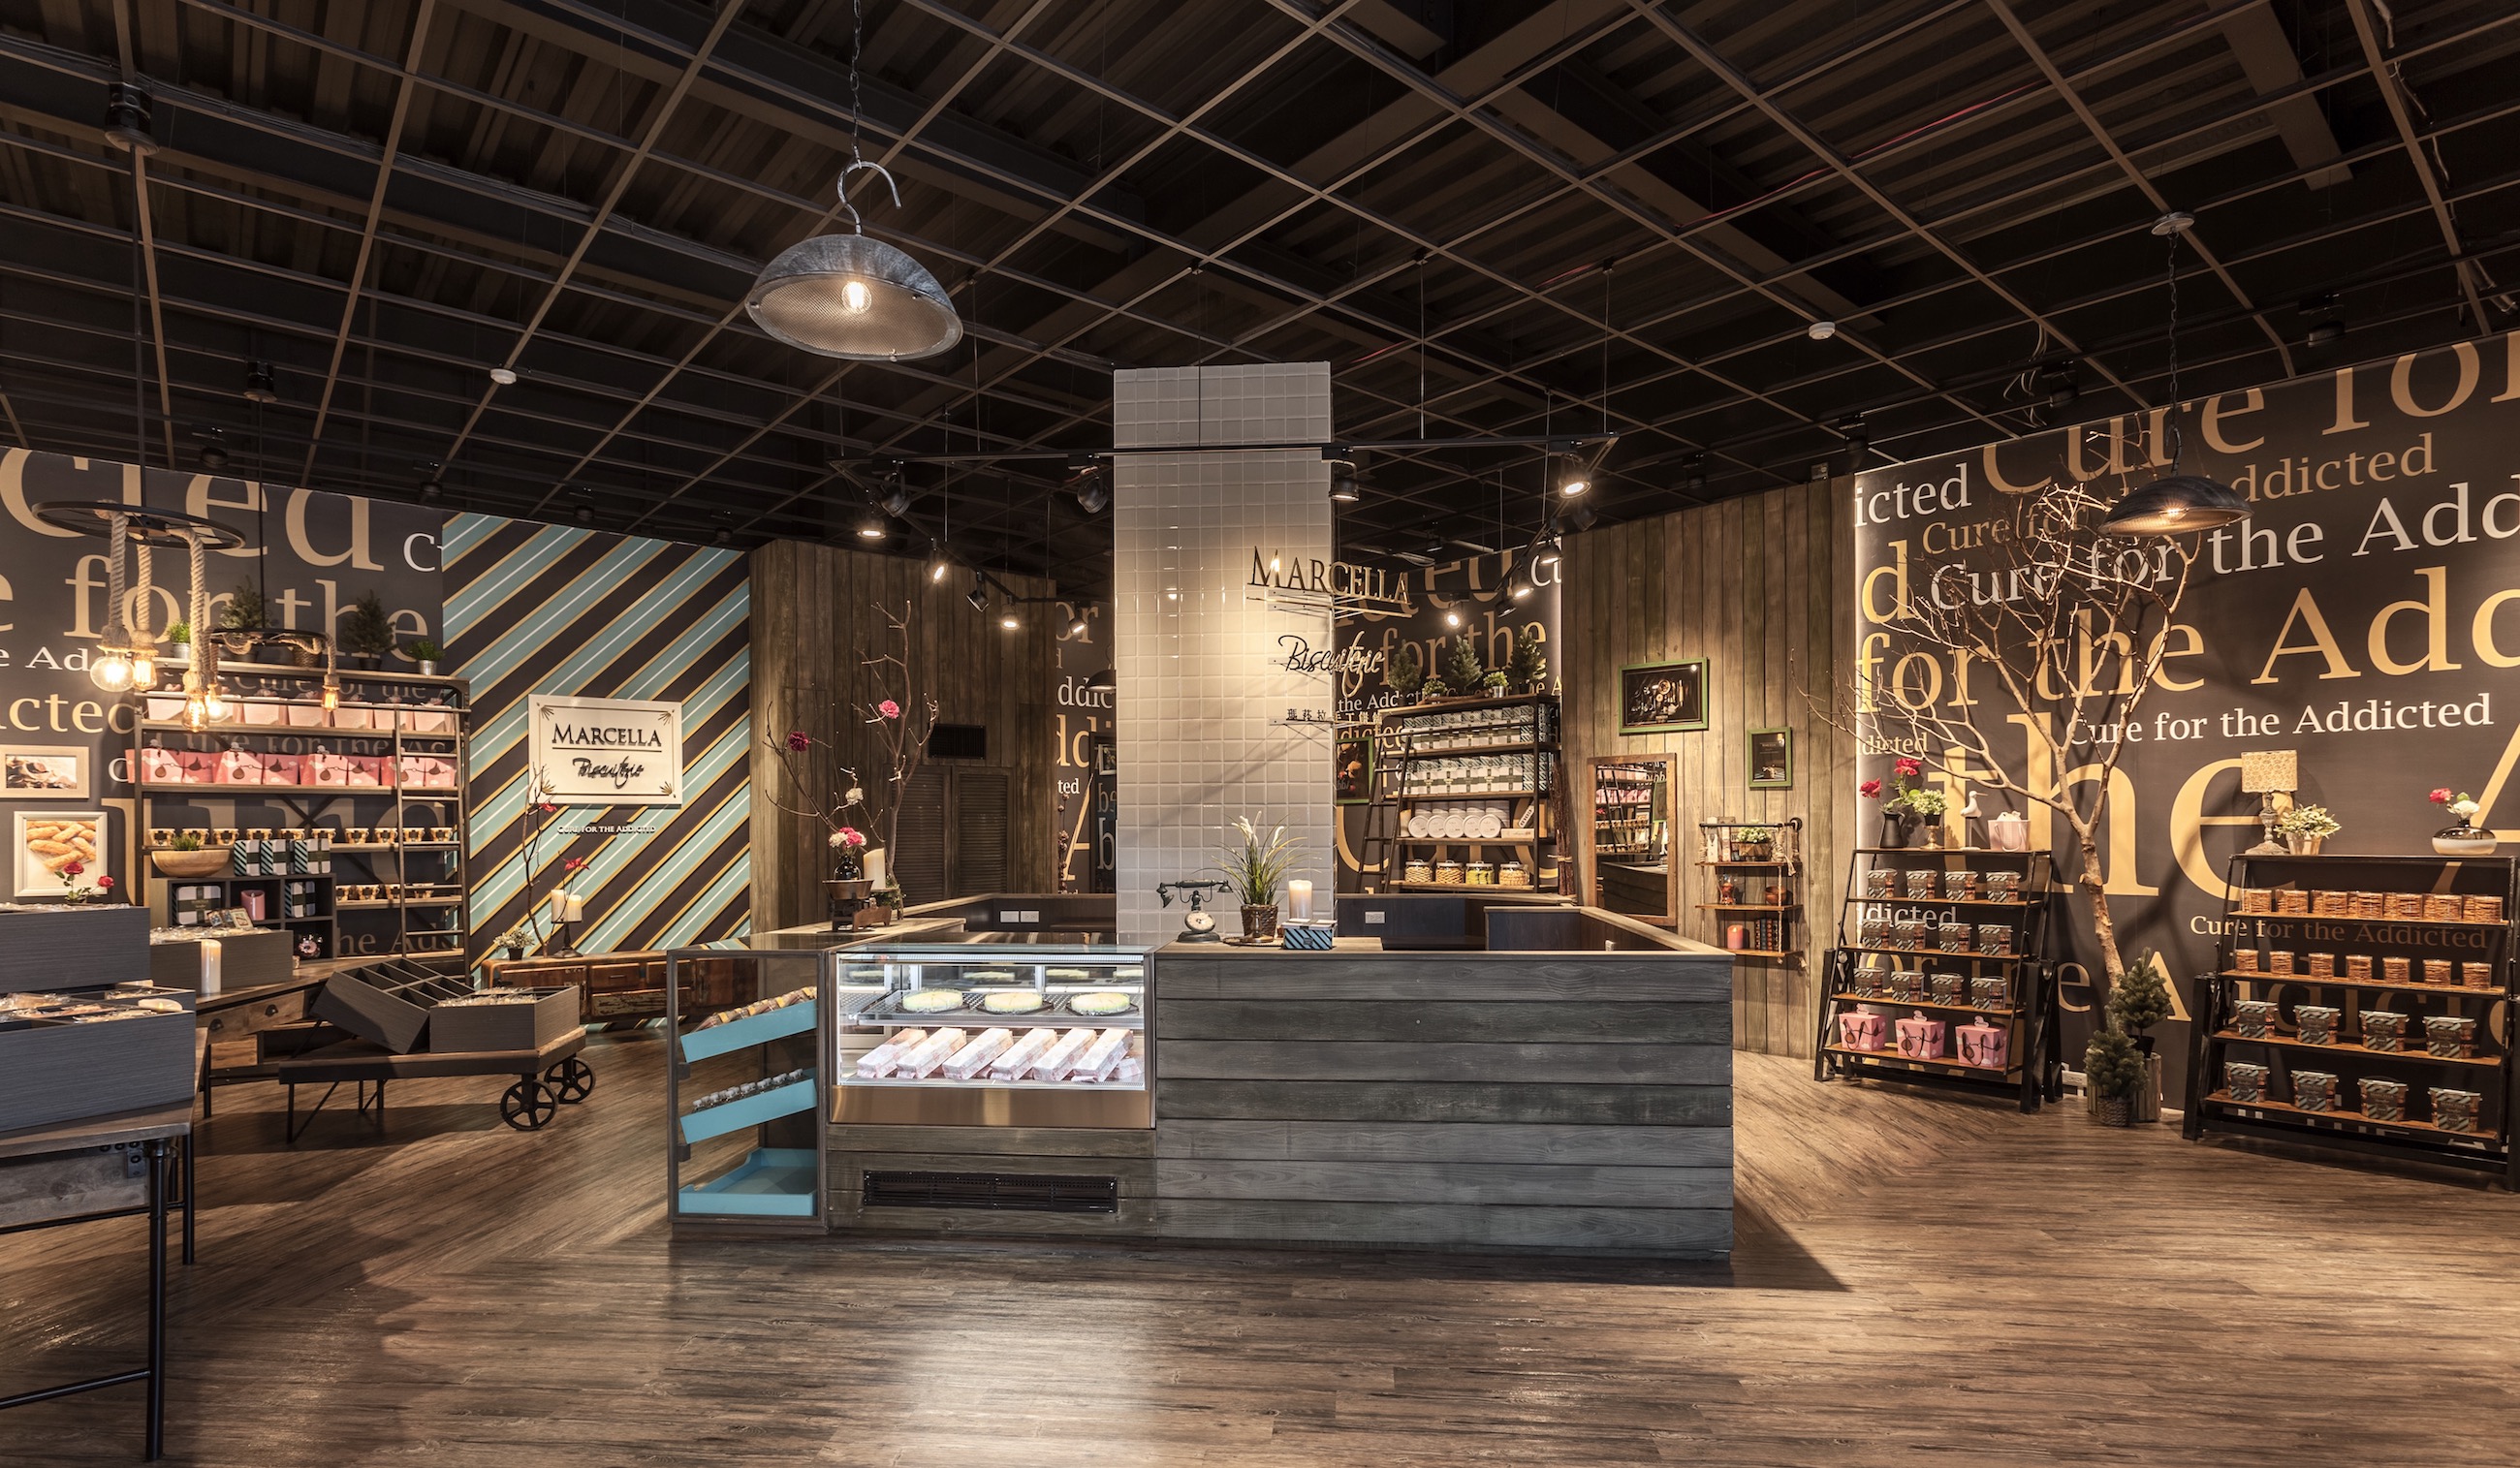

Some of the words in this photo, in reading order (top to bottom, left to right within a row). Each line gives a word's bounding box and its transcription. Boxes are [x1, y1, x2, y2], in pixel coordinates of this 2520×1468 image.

[1983, 388, 2265, 494] Cure
[1855, 462, 1971, 528] icted
[1922, 516, 2011, 555] Cure
[2232, 432, 2438, 503] ddicted
[1246, 547, 1412, 606] MARCELLA
[1930, 561, 2063, 610] Cure
[2086, 537, 2180, 592] for
[2207, 518, 2324, 576] the
[64, 554, 235, 644] for
[275, 579, 428, 663] the
[1855, 632, 1989, 714] for
[2028, 609, 2205, 702] the
[551, 723, 662, 747] MARCELLA
[1338, 697, 1363, 713] the
[2066, 718, 2143, 745] Cure
[2154, 712, 2208, 741] for
[2220, 707, 2280, 738] the
[2292, 693, 2495, 734] Addicted
[582, 826, 597, 834] FOR
[599, 826, 615, 834] THE
[615, 826, 657, 835] ADDICTED
[1928, 711, 2294, 901] the
[336, 927, 376, 954] he
[2189, 915, 2248, 937] Cure
[2255, 919, 2294, 938] for
[2304, 921, 2346, 941] the
[2354, 924, 2488, 949] Addicted
